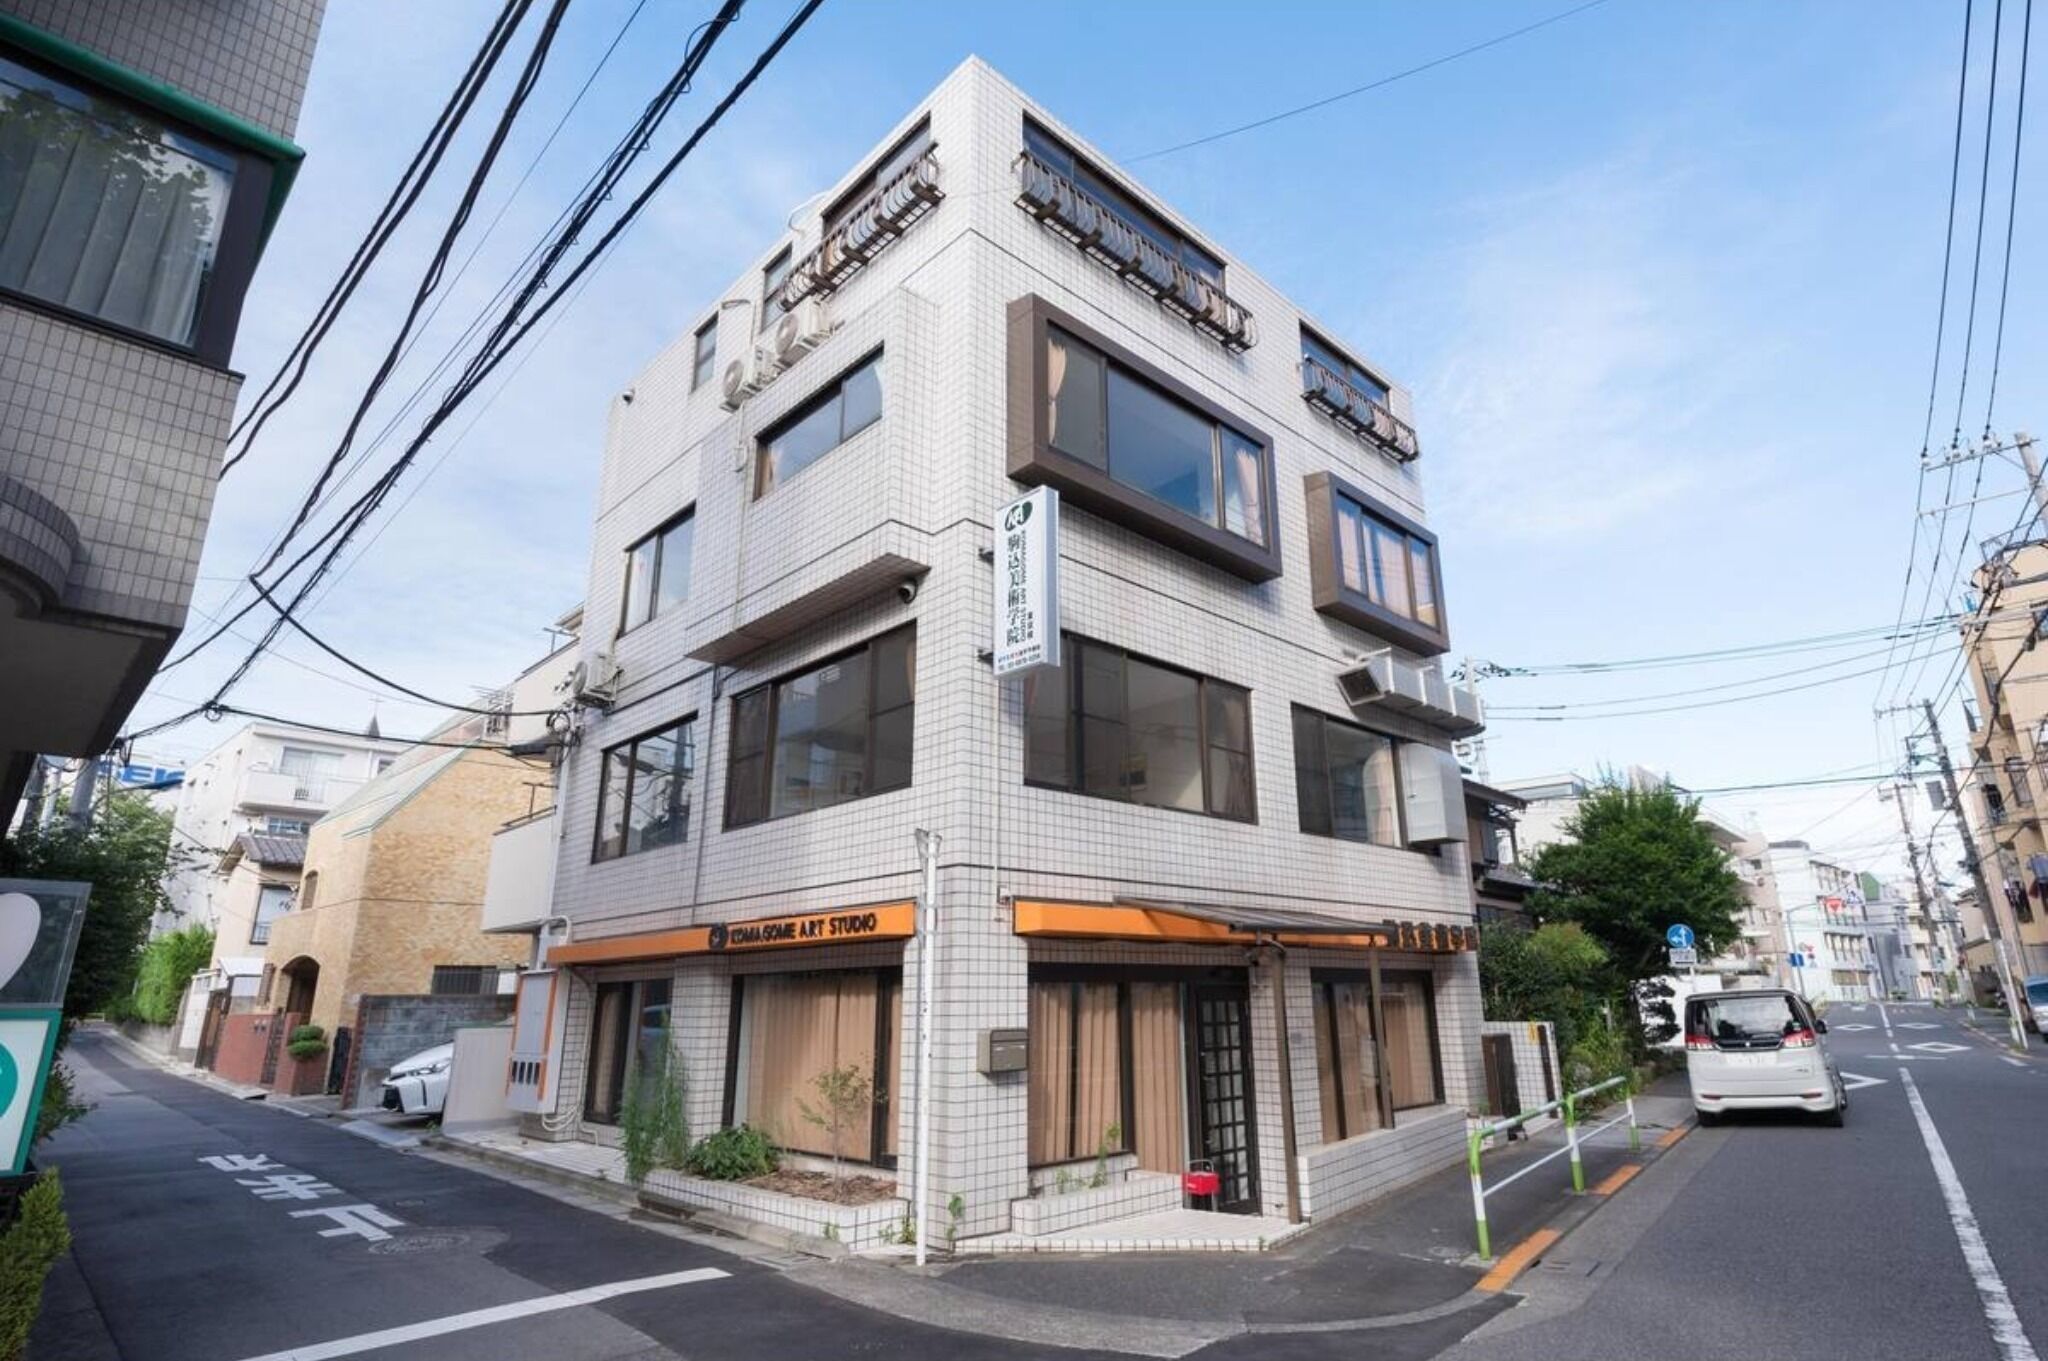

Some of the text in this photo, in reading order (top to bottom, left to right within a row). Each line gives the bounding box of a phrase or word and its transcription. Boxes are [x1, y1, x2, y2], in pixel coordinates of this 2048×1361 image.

[731, 912, 877, 945] KOMAGOME ART STUDIO
[197, 1153, 406, 1241] 止まれ
